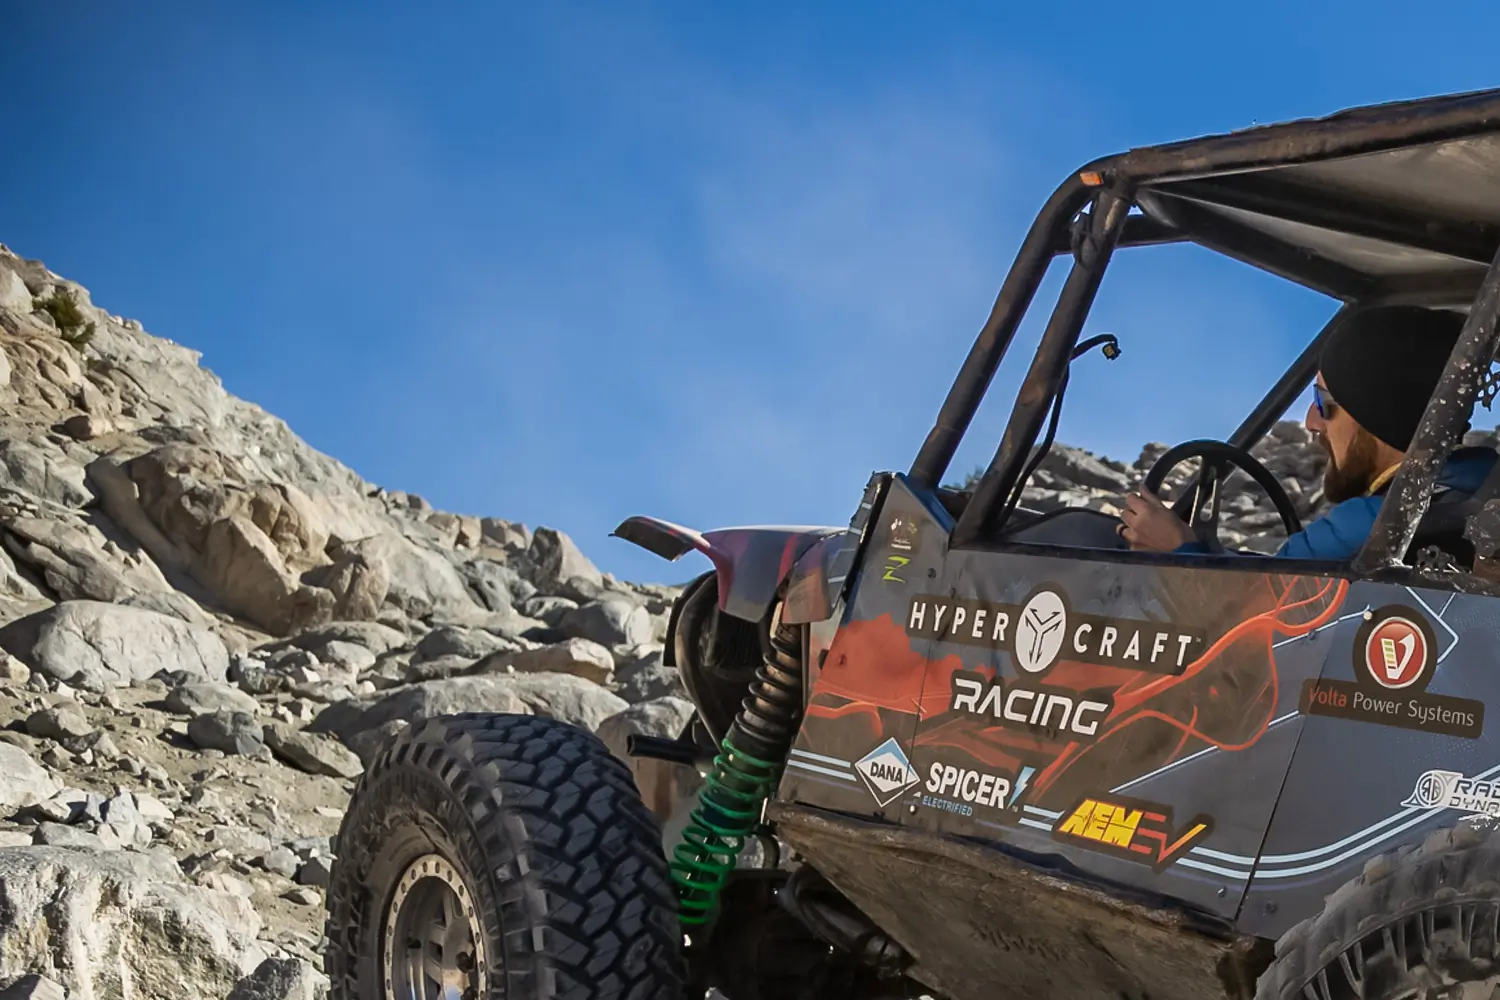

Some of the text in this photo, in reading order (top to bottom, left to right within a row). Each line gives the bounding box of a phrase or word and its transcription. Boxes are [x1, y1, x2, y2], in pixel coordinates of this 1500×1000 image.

[909, 601, 1192, 667] HYPER CRAFT
[954, 678, 1109, 736] RACING
[1308, 685, 1475, 727] Volta Power Systems
[870, 761, 903, 784] DANA
[925, 761, 1011, 810] SPICER
[922, 796, 973, 817] ELECTRIFIED
